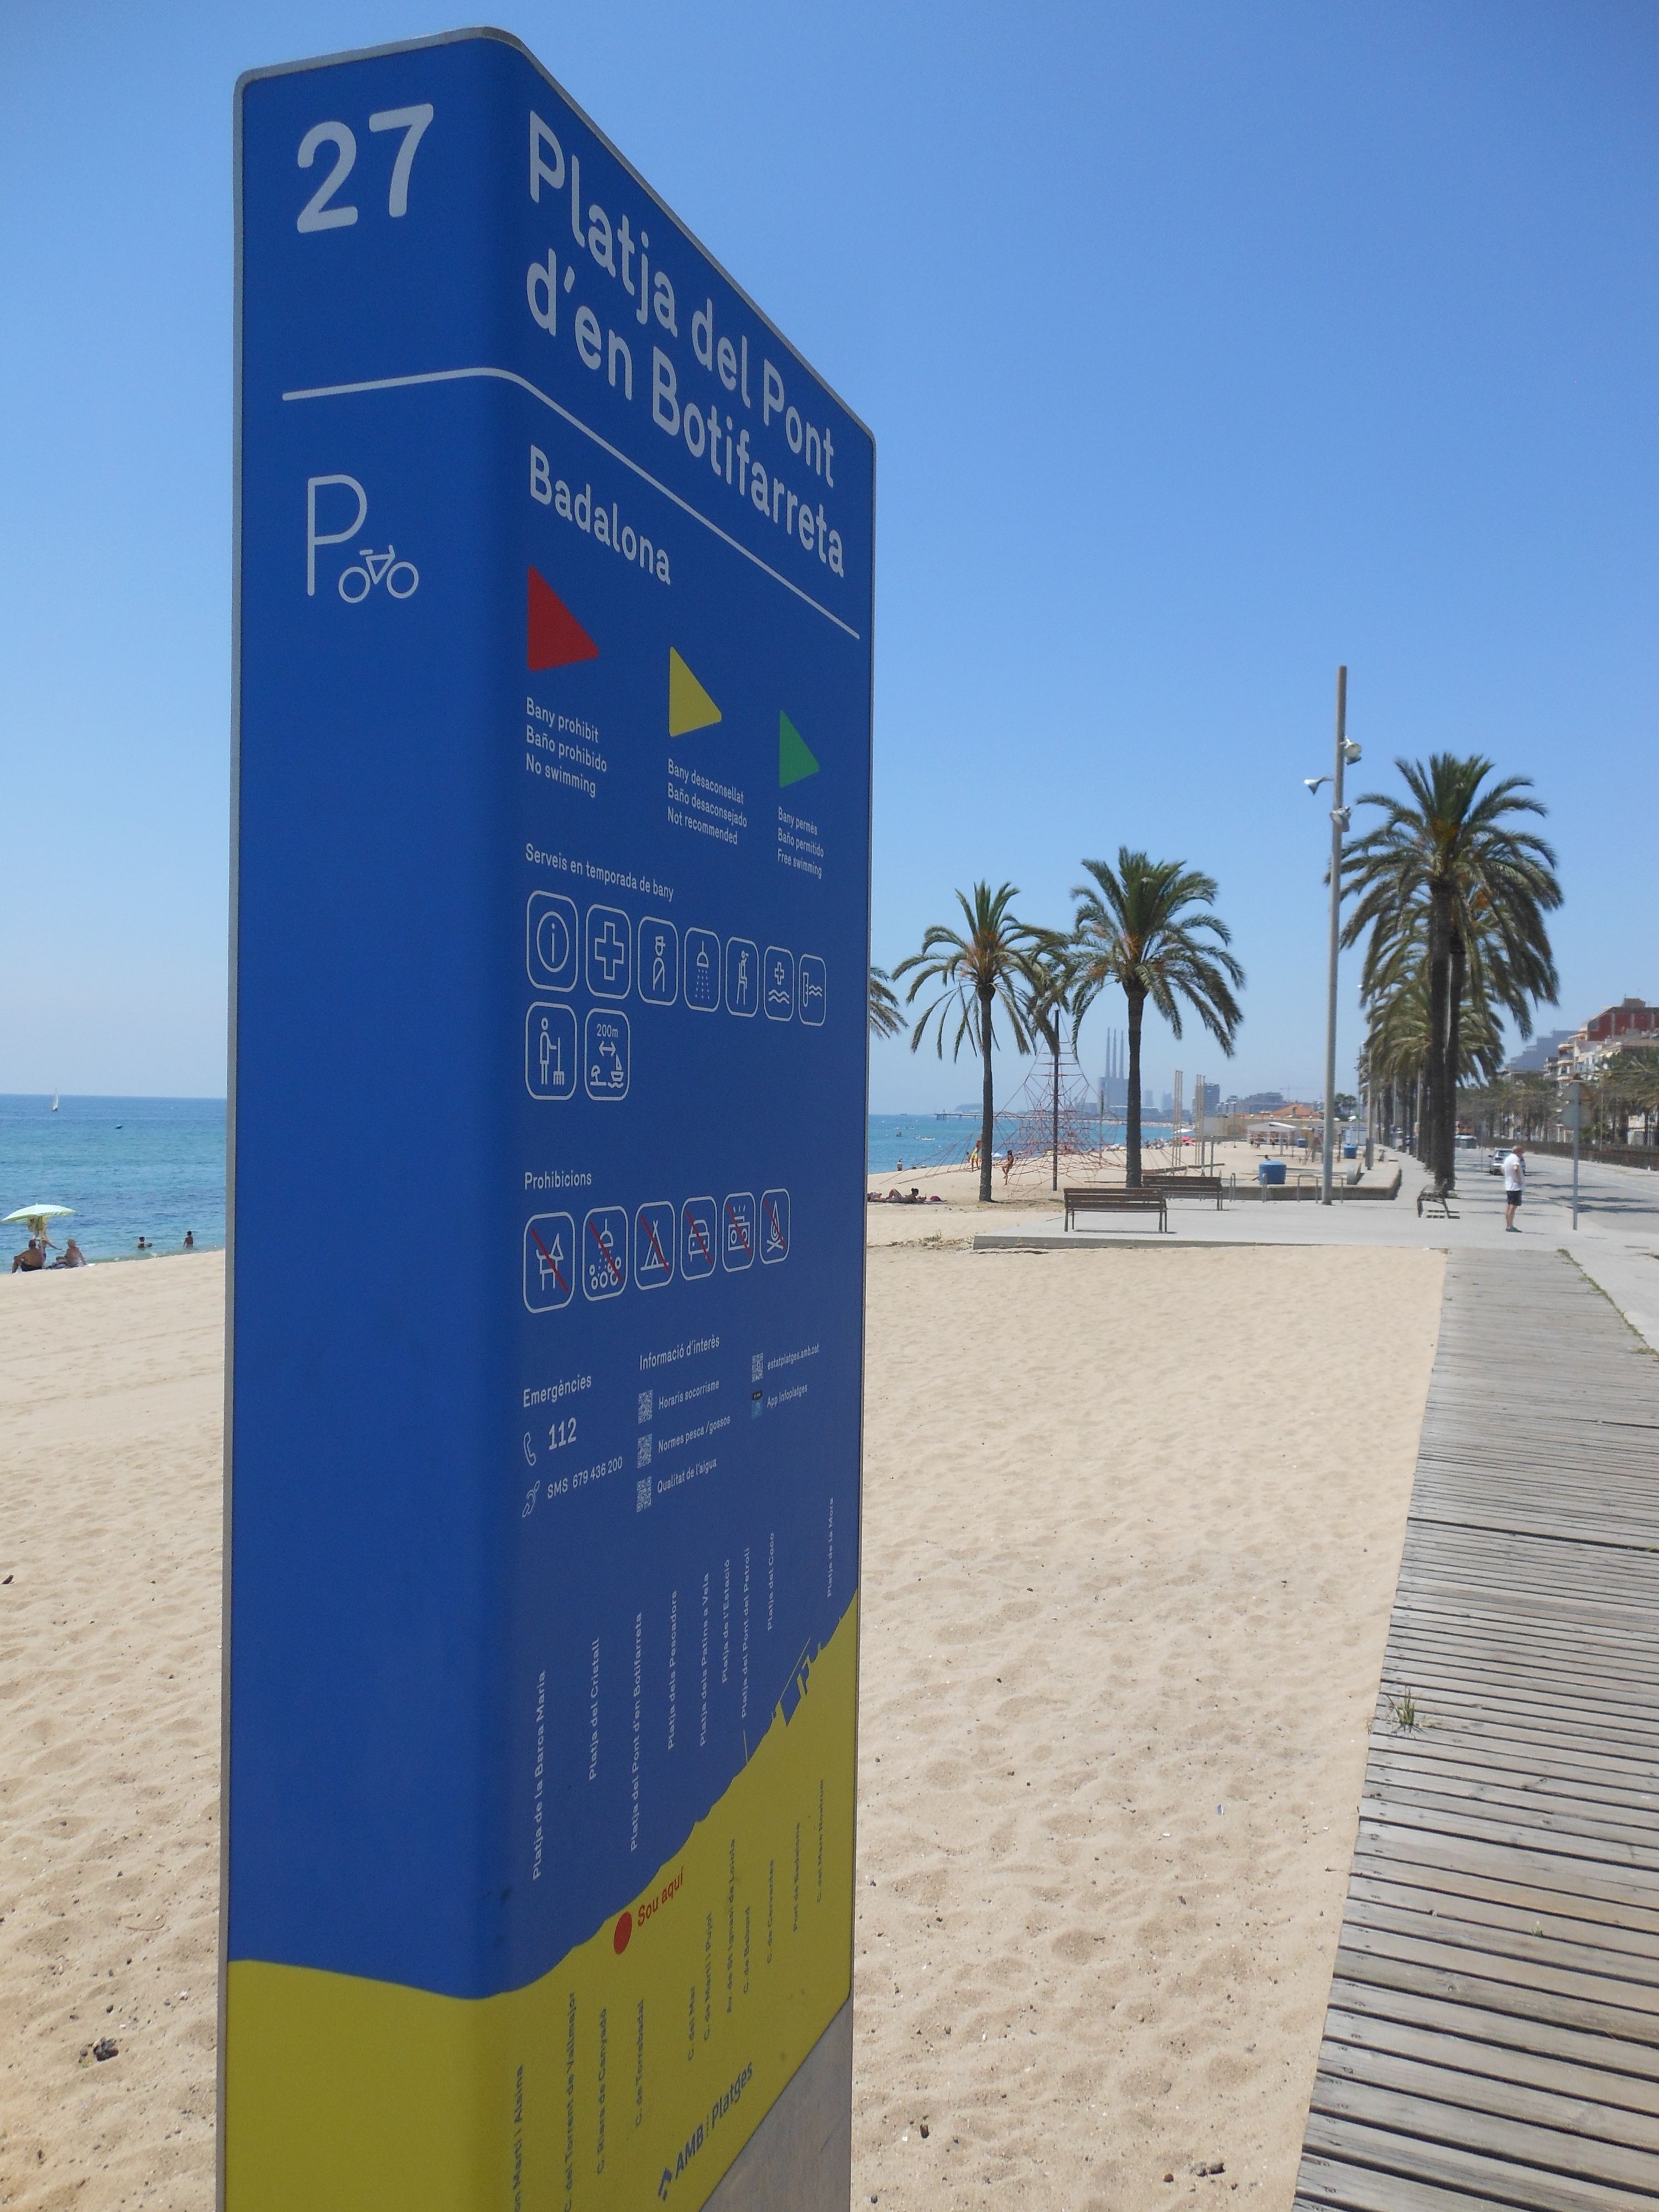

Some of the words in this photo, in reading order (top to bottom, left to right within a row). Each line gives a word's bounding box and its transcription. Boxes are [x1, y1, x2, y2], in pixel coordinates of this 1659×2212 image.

[296, 102, 435, 234] 27
[529, 109, 679, 338] Platja
[691, 299, 752, 409] del
[763, 358, 834, 488] Pont
[526, 248, 633, 401] d'en
[651, 346, 844, 578] Botifarreta
[530, 444, 671, 586] Badalona
[526, 697, 555, 727] Bany
[558, 717, 599, 744] prohibit
[526, 725, 555, 753] Baño
[558, 742, 607, 773] prohibido
[526, 753, 542, 774] No
[545, 763, 596, 799] swimming
[668, 758, 689, 784] Bany
[691, 769, 744, 805] desaconsellat
[667, 782, 689, 806] Baño
[691, 795, 748, 828] desaconsejado
[667, 807, 682, 826] Not
[684, 813, 738, 845] recommended
[778, 807, 795, 827] Bany
[796, 817, 817, 836] permès
[778, 828, 794, 848] Baño
[796, 834, 824, 859] permitido
[778, 848, 791, 865] Free
[793, 855, 822, 879] swimming
[525, 843, 568, 873] Serveis
[571, 860, 583, 876] en
[586, 862, 638, 890] temporada
[639, 874, 651, 893] de
[653, 878, 674, 902] bany
[596, 1022, 619, 1039] 200m
[524, 1169, 592, 1190] Prohibicions
[639, 1344, 685, 1371] Informació
[686, 1334, 720, 1358] d'interès
[523, 1374, 592, 1408] Emergències
[659, 1392, 684, 1411] Horaris
[685, 1380, 719, 1404] socorrisme
[766, 1394, 779, 1410] App
[779, 1384, 808, 1404] Infoplatges
[548, 1416, 577, 1452] 112
[658, 1434, 684, 1453] Normes
[685, 1427, 705, 1446] pesca
[706, 1415, 731, 1436] /gossos
[547, 1477, 568, 1500] SMS
[572, 1469, 589, 1489] 679
[590, 1461, 607, 1484] 436
[608, 1456, 623, 1477] 200
[657, 1473, 686, 1495] Qualitat
[686, 1470, 695, 1486] de
[696, 1458, 717, 1483] l'aigua
[669, 1590, 677, 1668] Pescadors
[703, 1606, 709, 1616] a
[722, 1621, 729, 1639] de
[590, 1637, 600, 1699] Cristall
[633, 1611, 642, 1698] Botifarreta
[721, 1640, 730, 1683] Platja
[535, 1670, 546, 1723] Maria
[668, 1670, 676, 1702] dels
[589, 1700, 599, 1728] del
[632, 1699, 640, 1732] d'en
[667, 1703, 676, 1750] Platja
[700, 1701, 708, 1747] Platja
[534, 1723, 545, 1778] Barca
[588, 1729, 599, 1781] Platja
[632, 1734, 640, 1774] Pont
[534, 1778, 544, 1799] la
[631, 1774, 639, 1801] del
[534, 1800, 543, 1823] de
[630, 1802, 640, 1852] Platja
[532, 1825, 544, 1881] Platja
[638, 1896, 659, 1927] Sou
[662, 1866, 684, 1903] aquí
[675, 2124, 703, 2180] AMB
[712, 2062, 752, 2129] Platges
